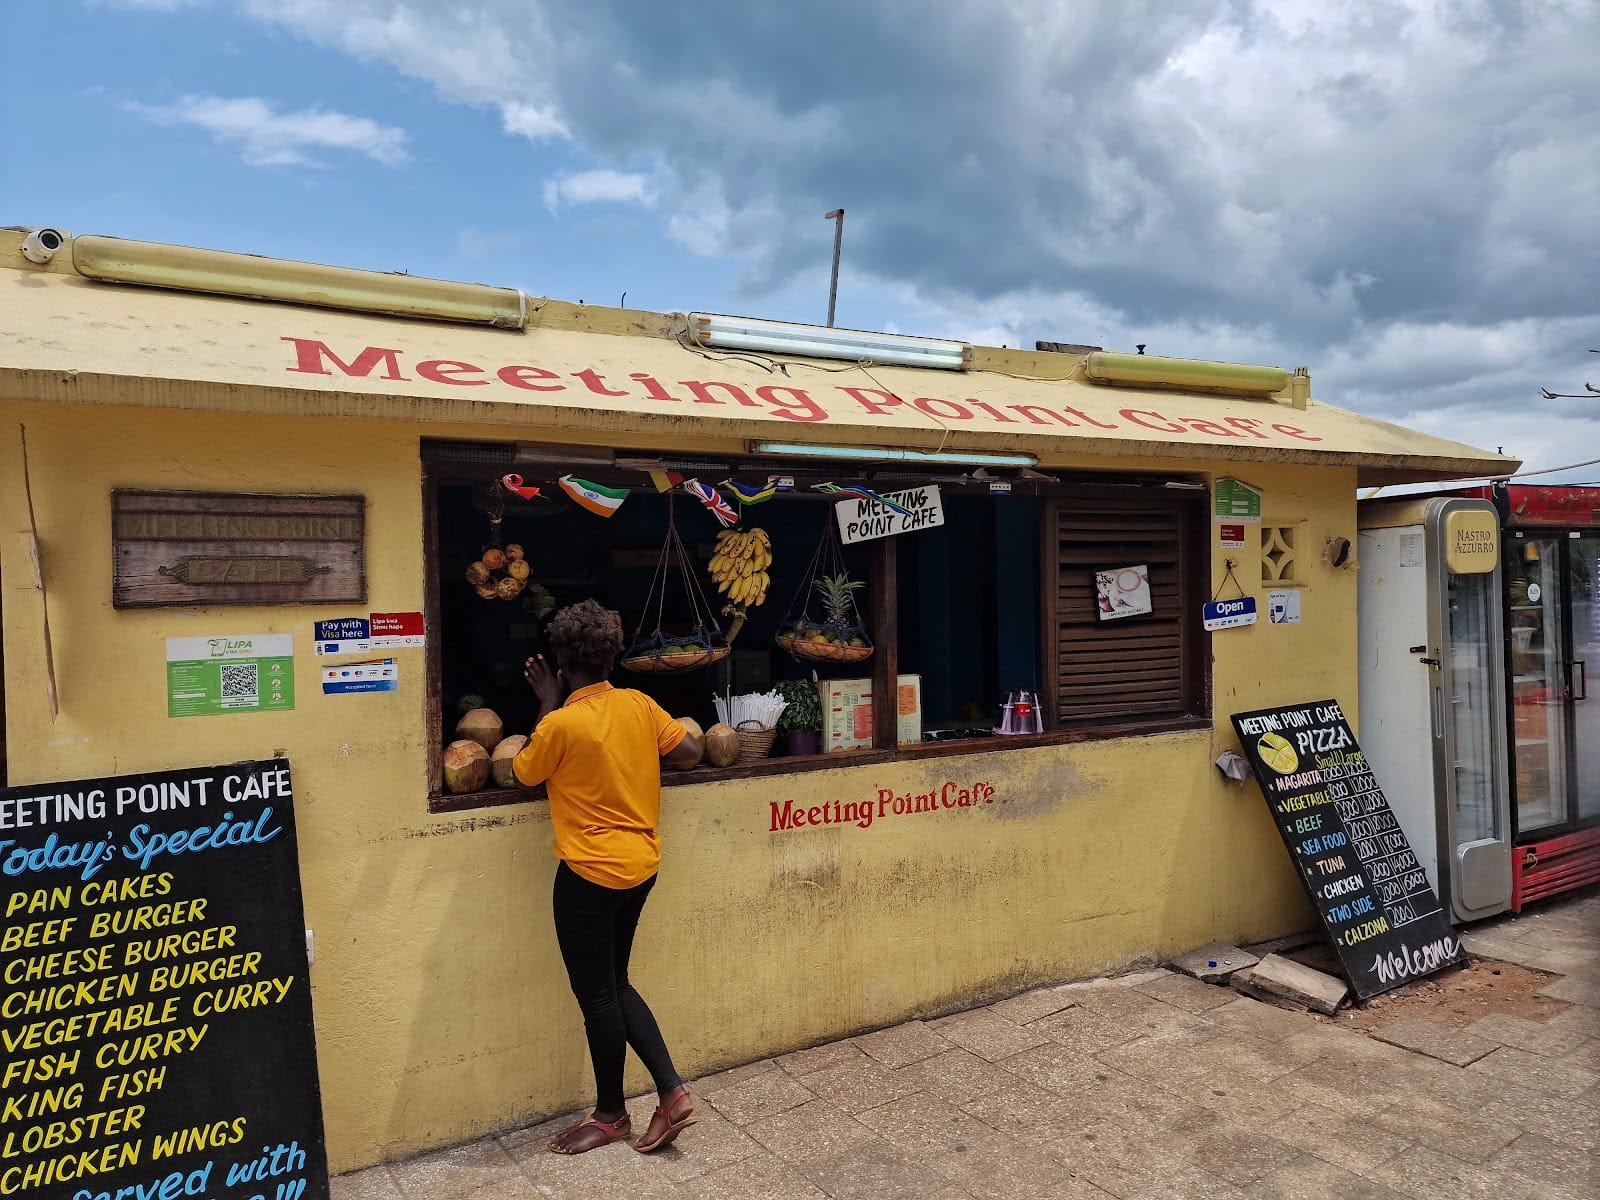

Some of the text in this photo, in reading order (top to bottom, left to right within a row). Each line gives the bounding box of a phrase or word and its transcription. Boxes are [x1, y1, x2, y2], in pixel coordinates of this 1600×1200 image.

[279, 336, 829, 423] Meeting
[835, 386, 1118, 430] Point
[847, 506, 938, 540] POINT CAFE
[1457, 530, 1491, 541] NASTRO
[1455, 542, 1494, 553] AZZURRO
[1216, 601, 1244, 615] Open
[321, 629, 363, 639] Visa here
[322, 620, 362, 631] Pay with
[227, 640, 253, 648] LIPA
[1239, 714, 1283, 735] MEETING
[1280, 709, 1314, 729] POINT
[1296, 725, 1353, 756] PIZZA
[116, 777, 214, 816] POINT
[1275, 770, 1324, 791] MAGARITA
[769, 799, 875, 830] Meeting
[877, 788, 940, 818] Point
[1281, 789, 1332, 813] VEGETABLE
[122, 806, 283, 871] Special
[1295, 813, 1323, 834] BEEF
[1302, 837, 1322, 856] SEA
[1323, 831, 1348, 848] FOOD
[1316, 855, 1347, 876] TUNA
[5, 872, 175, 918] PAN CAKES
[1323, 873, 1364, 900] CHICKEN
[0, 898, 208, 953] BEEF BURGER
[1328, 905, 1352, 924] TWO
[1351, 895, 1376, 917] SIDE
[1344, 916, 1390, 946] CALZONA
[4, 925, 237, 985] CHEESE BURGER
[1368, 935, 1462, 984] Welcome
[1, 951, 262, 1019] CHICKEN BURGER
[1, 975, 294, 1053] VEGETABLE CURRY
[1, 1023, 209, 1090] FISH CURRY
[1, 1065, 167, 1124] KING FISH
[1, 1104, 146, 1159] LOBSTER
[0, 1116, 247, 1196] CHICKEN WINGS
[72, 1160, 213, 1200] rved
[225, 1140, 307, 1187] with
